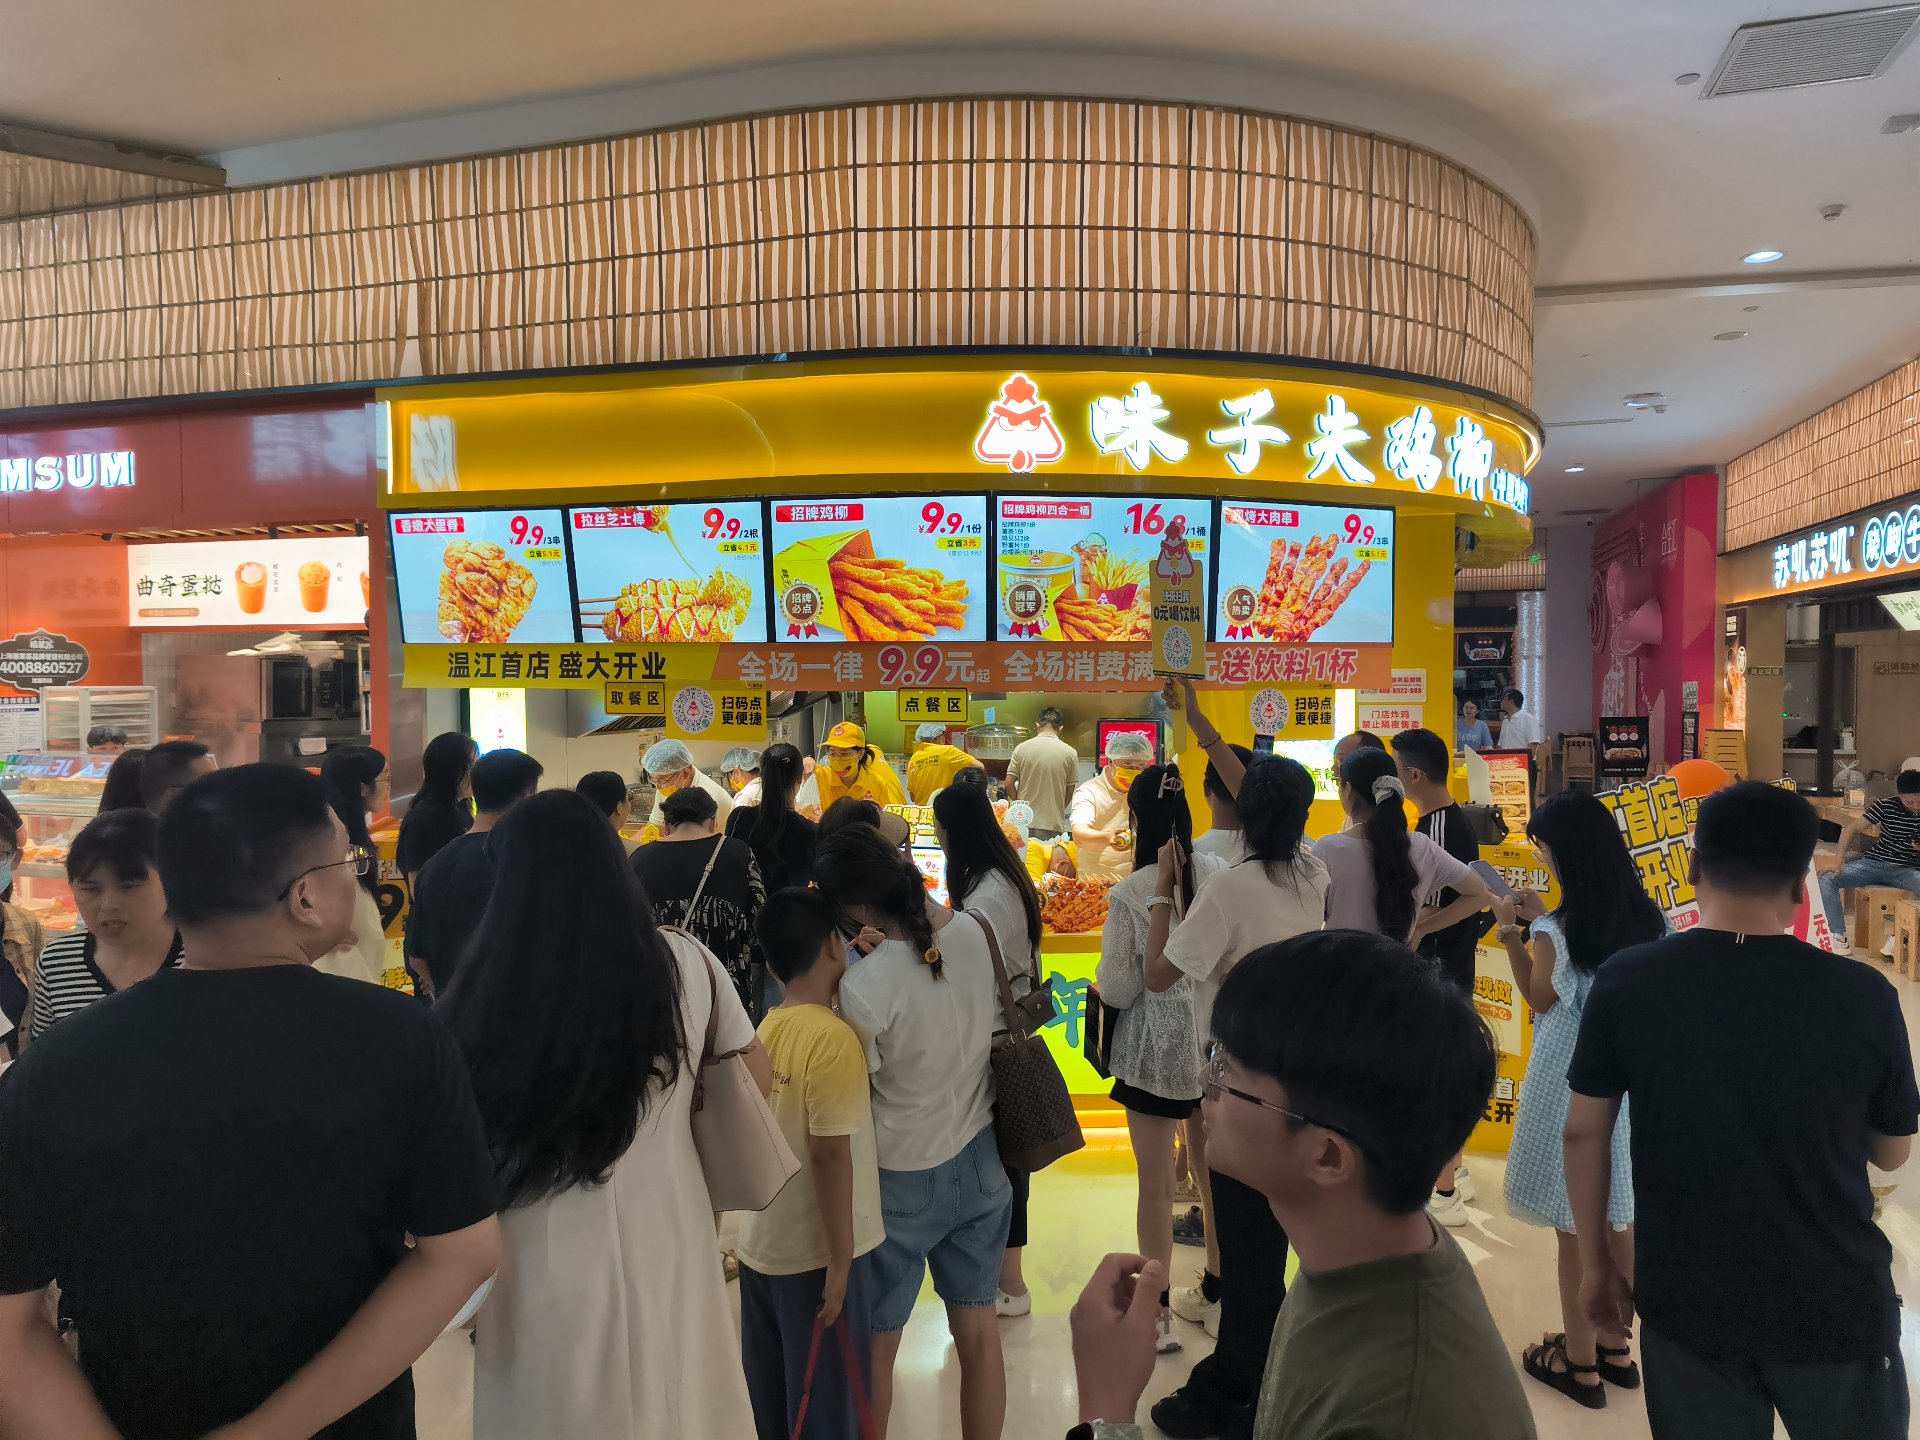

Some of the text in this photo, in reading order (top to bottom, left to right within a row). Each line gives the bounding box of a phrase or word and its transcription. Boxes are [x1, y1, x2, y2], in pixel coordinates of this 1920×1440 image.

[1091, 381, 1495, 501] 味子夫鸡柳
[0, 451, 135, 492] MSUM
[791, 506, 848, 520] 招牌鸡柳
[1003, 504, 1090, 516] 招牌鸡柳四合一桶
[401, 519, 458, 533] 香嫩大里脊
[581, 512, 645, 526] 拉丝芝士棒
[723, 543, 757, 552] 立省4.1元
[947, 539, 977, 548] 立省3元
[529, 550, 560, 558] 立省5.1元
[1358, 550, 1387, 558] 立省5.1元
[1774, 526, 1851, 589] 苏叽苏叽
[136, 574, 223, 598] 曲奇蛋挞
[791, 593, 812, 603] 招牌
[1015, 590, 1037, 601] 销量
[1232, 594, 1251, 605] 人气
[791, 604, 812, 614] 必点
[1015, 601, 1037, 612] 冠军
[1153, 605, 1200, 622] 0元喝饮料
[1232, 606, 1251, 616] 热卖
[0, 662, 83, 673] 4008860527
[448, 651, 667, 680] 温江首店 盛大开业
[611, 691, 660, 706] 取餐区
[721, 696, 762, 711] 扫码点
[905, 698, 962, 713] 点餐区
[1295, 697, 1332, 711] 扫码点
[721, 711, 762, 726] 更便捷
[1295, 711, 1332, 726] 更便捷
[1372, 710, 1409, 719] 门店炸鸡
[1362, 720, 1420, 729] 禁止隔夜售卖
[1600, 778, 1689, 852] 首店
